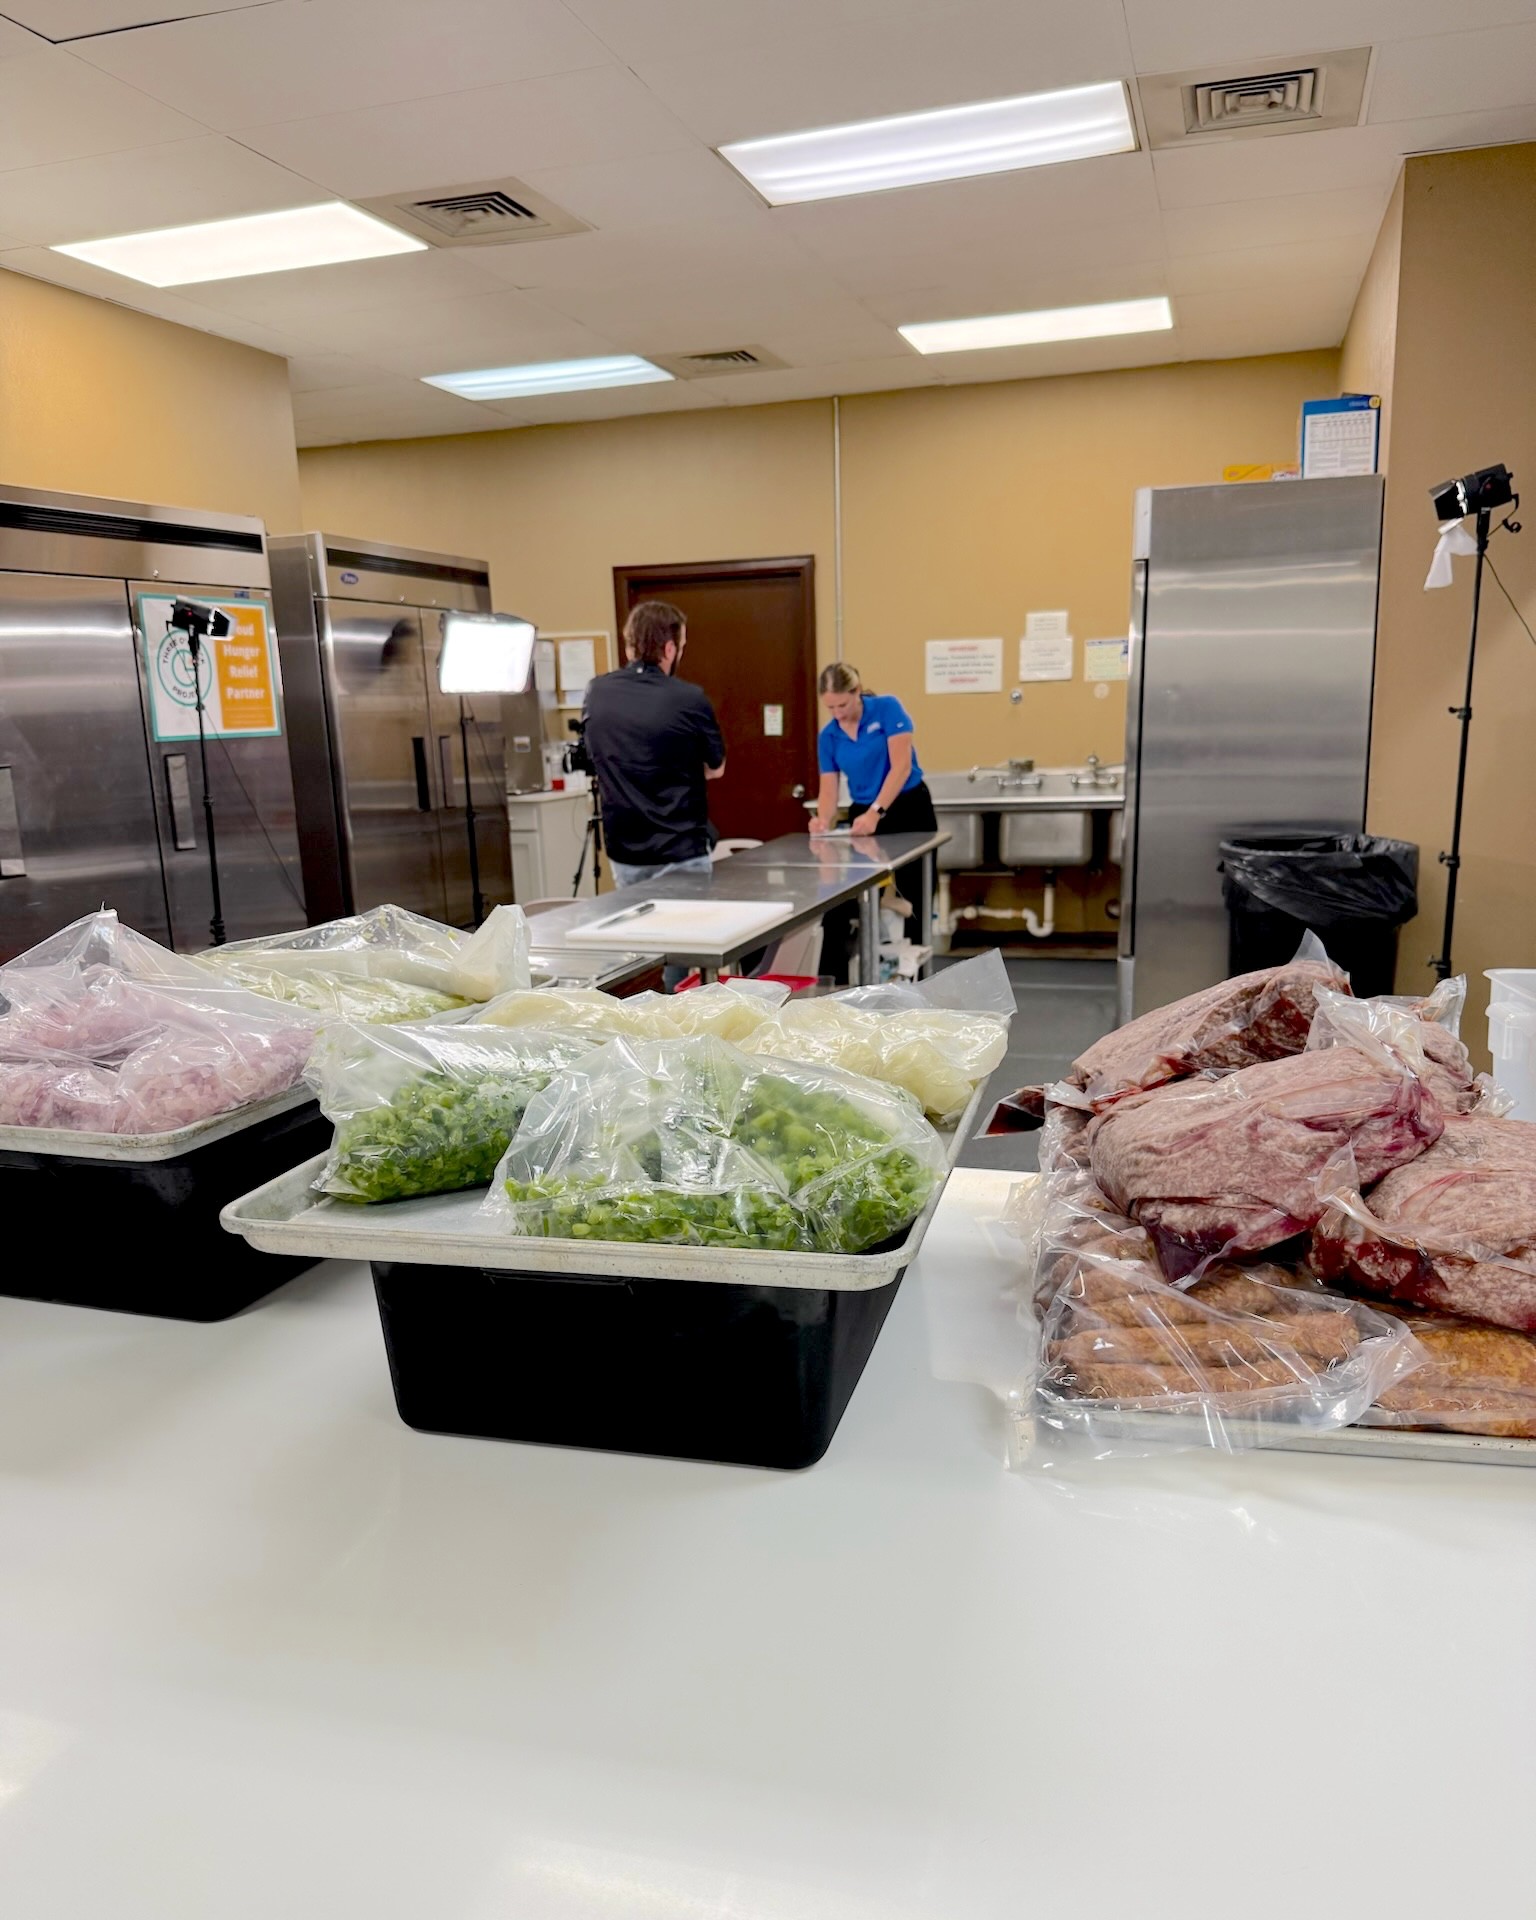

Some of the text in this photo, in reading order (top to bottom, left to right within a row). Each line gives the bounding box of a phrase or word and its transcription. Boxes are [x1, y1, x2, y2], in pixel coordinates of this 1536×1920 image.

[223, 644, 260, 660] Hunger
[230, 665, 257, 677] Relief
[227, 687, 264, 698] Partner
